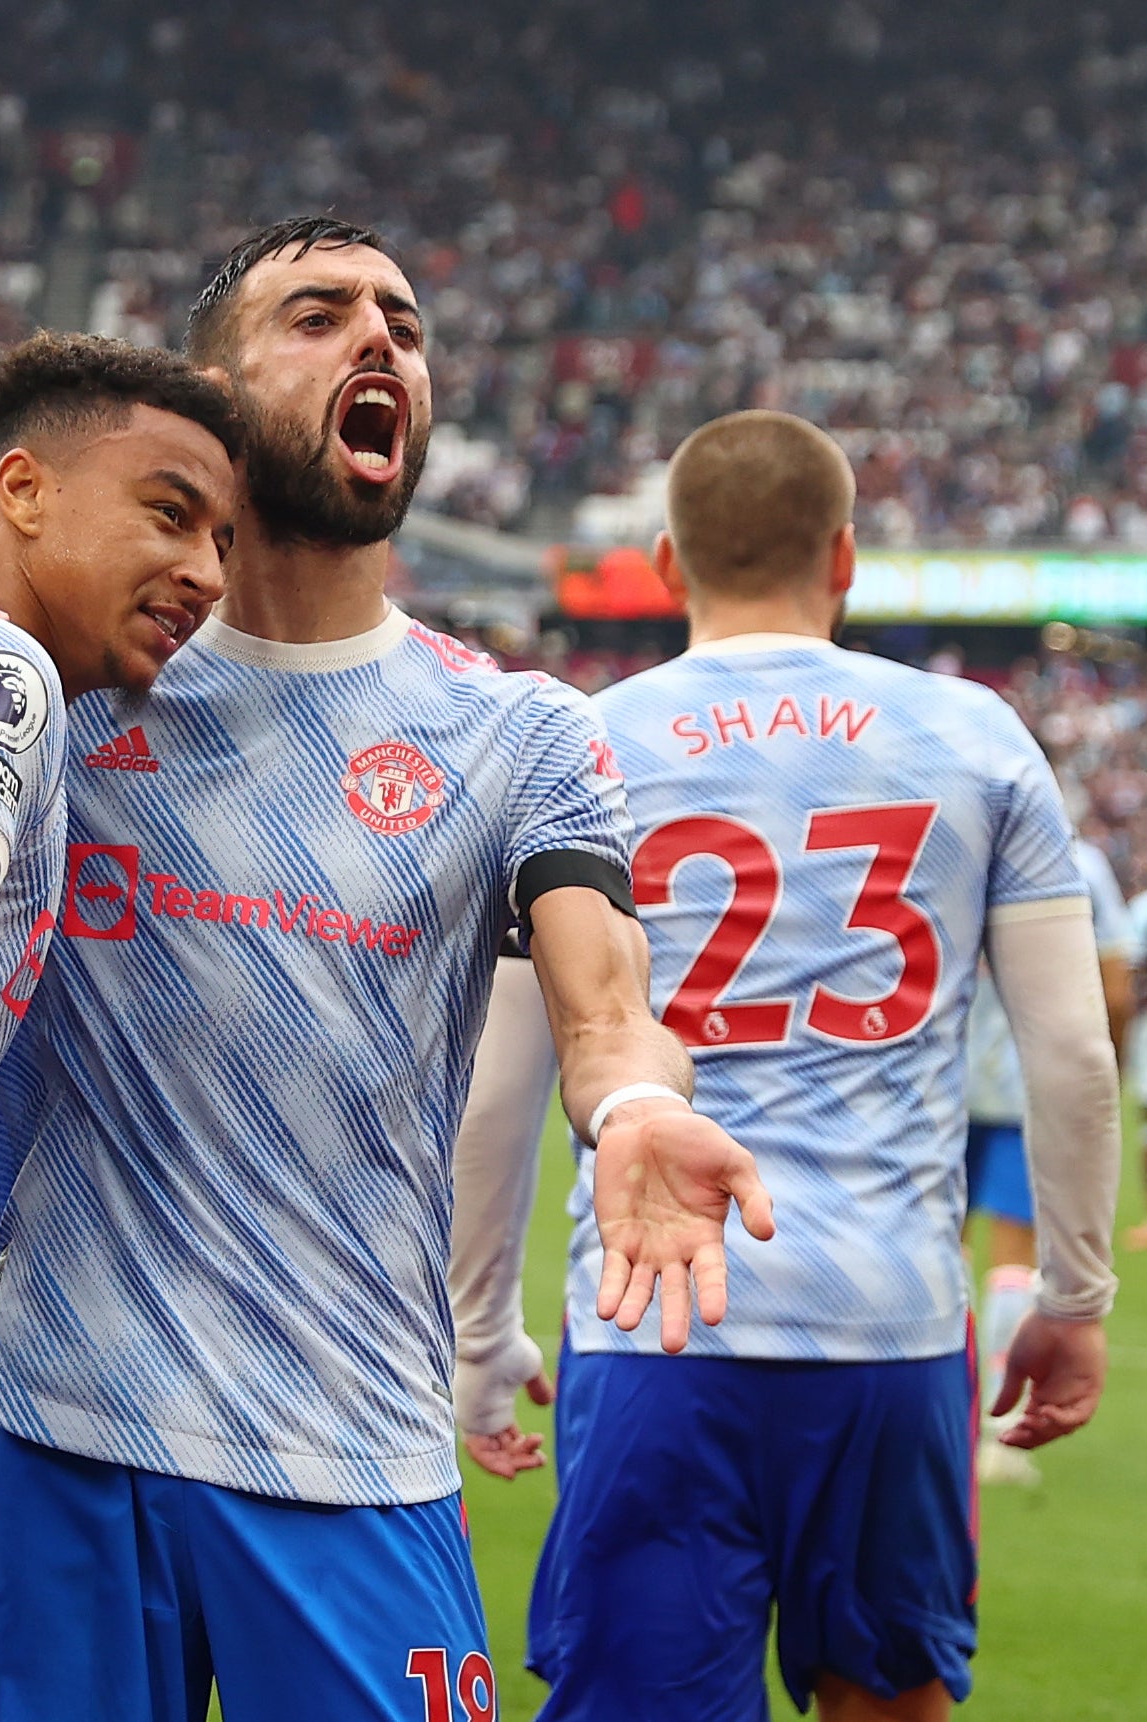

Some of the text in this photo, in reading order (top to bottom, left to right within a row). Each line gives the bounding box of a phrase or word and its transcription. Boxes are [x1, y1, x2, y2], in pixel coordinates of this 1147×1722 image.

[672, 694, 879, 756] SHAW
[84, 753, 160, 774] adidas
[354, 745, 437, 788] MANCHESTER
[359, 807, 417, 830] UNITED
[143, 872, 422, 959] TeamViewer
[630, 798, 943, 1052] 23
